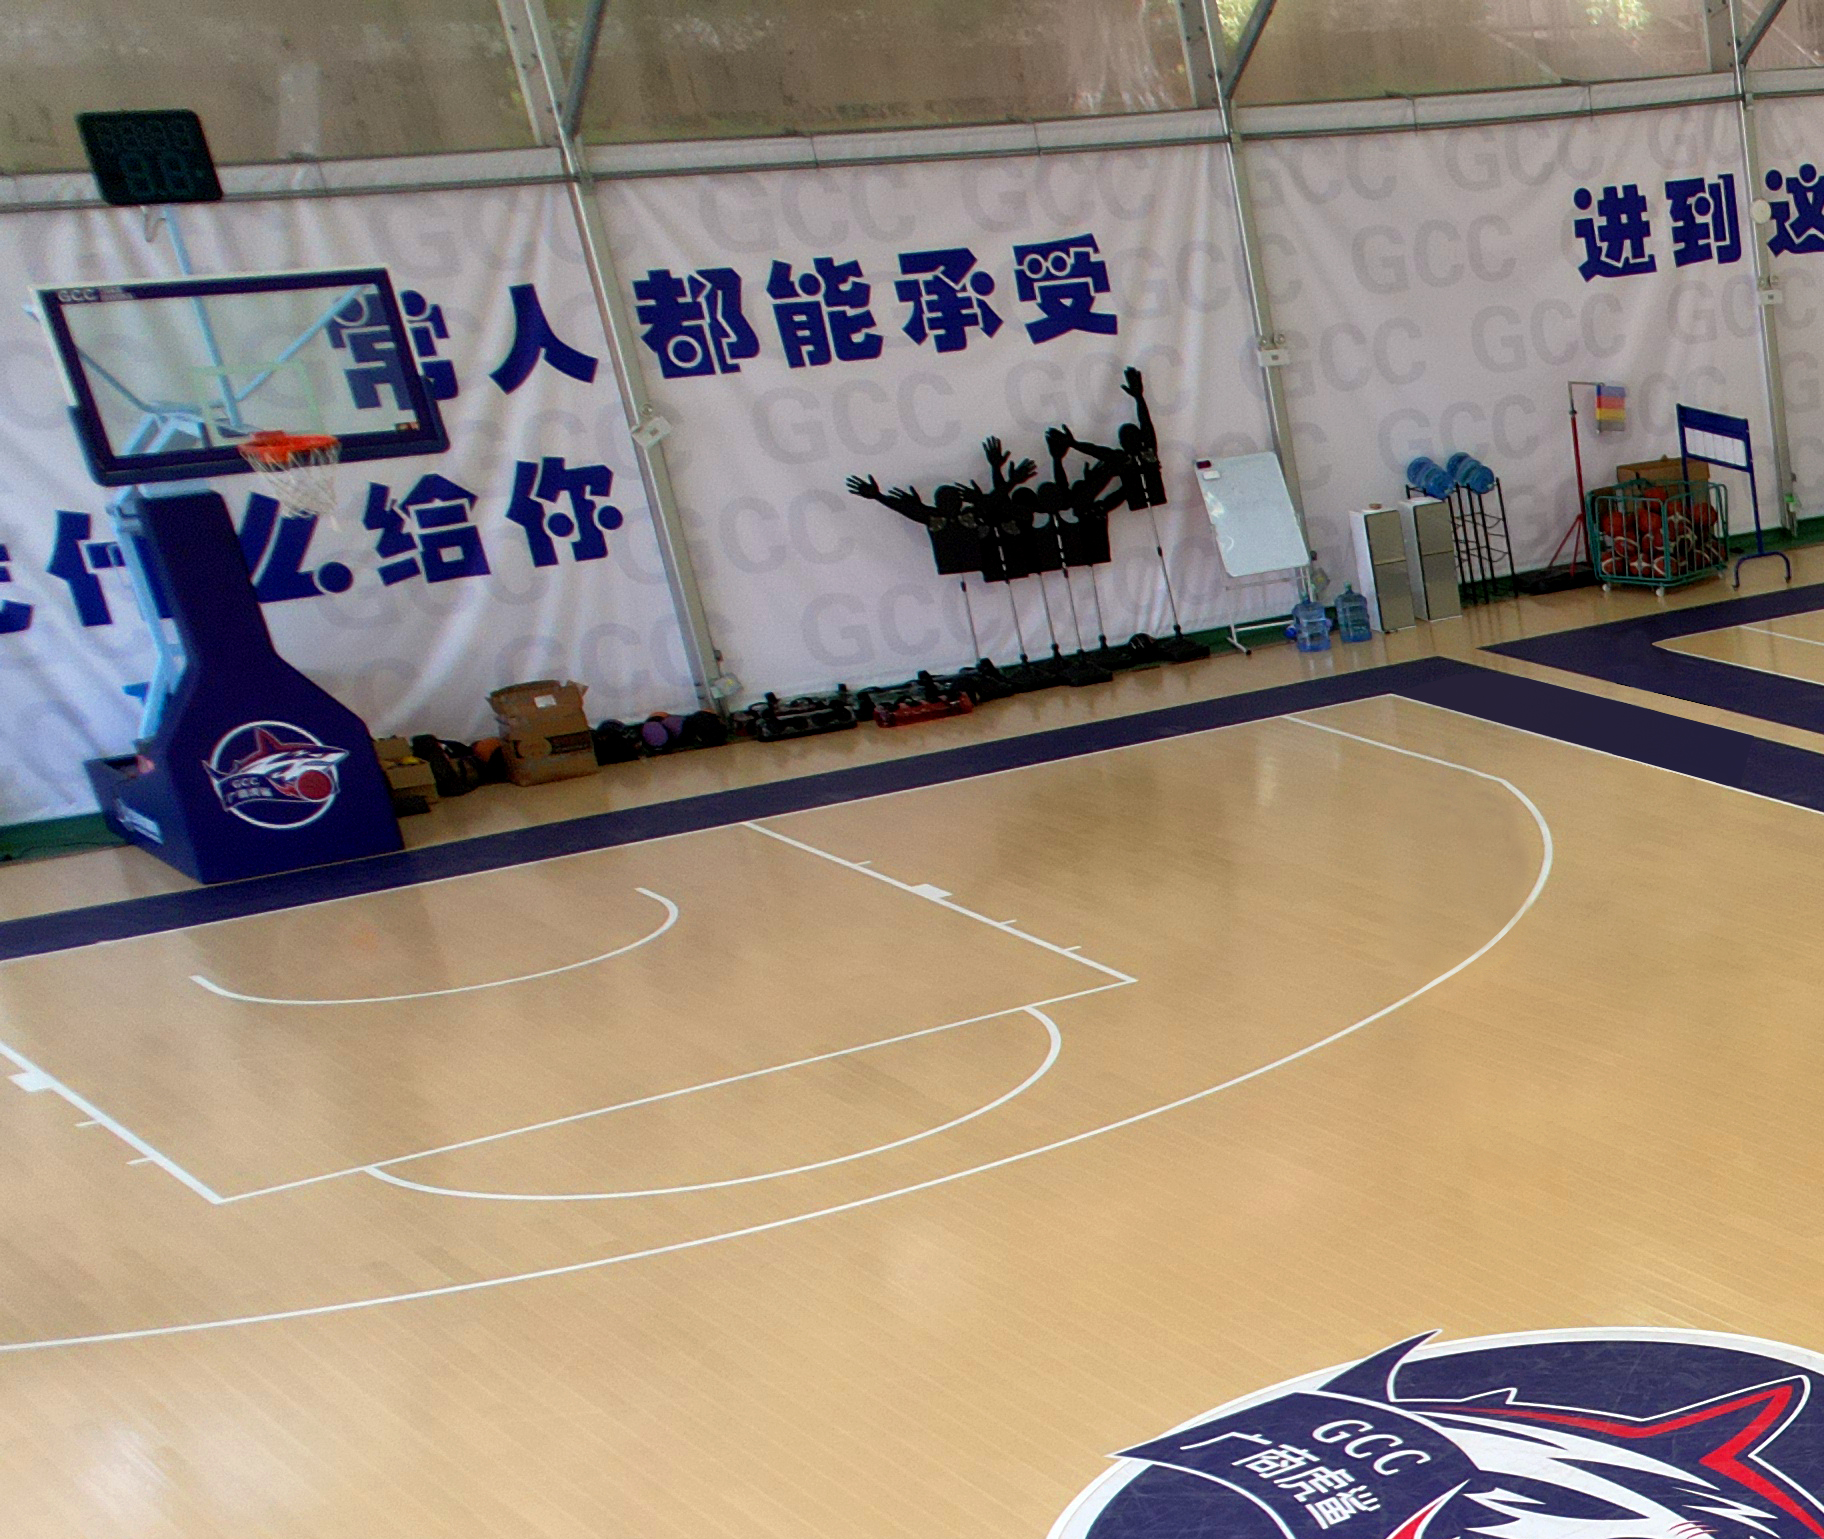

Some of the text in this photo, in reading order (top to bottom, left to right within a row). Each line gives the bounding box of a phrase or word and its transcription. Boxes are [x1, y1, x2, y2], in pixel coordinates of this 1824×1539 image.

[1350, 214, 1517, 296] GCC
[1469, 292, 1627, 374] GCC
[752, 371, 962, 466] GCC
[0, 455, 625, 637] 什么给你
[1179, 1431, 1382, 1530] 广商虎鲨
[1311, 1418, 1432, 1476] GCC
